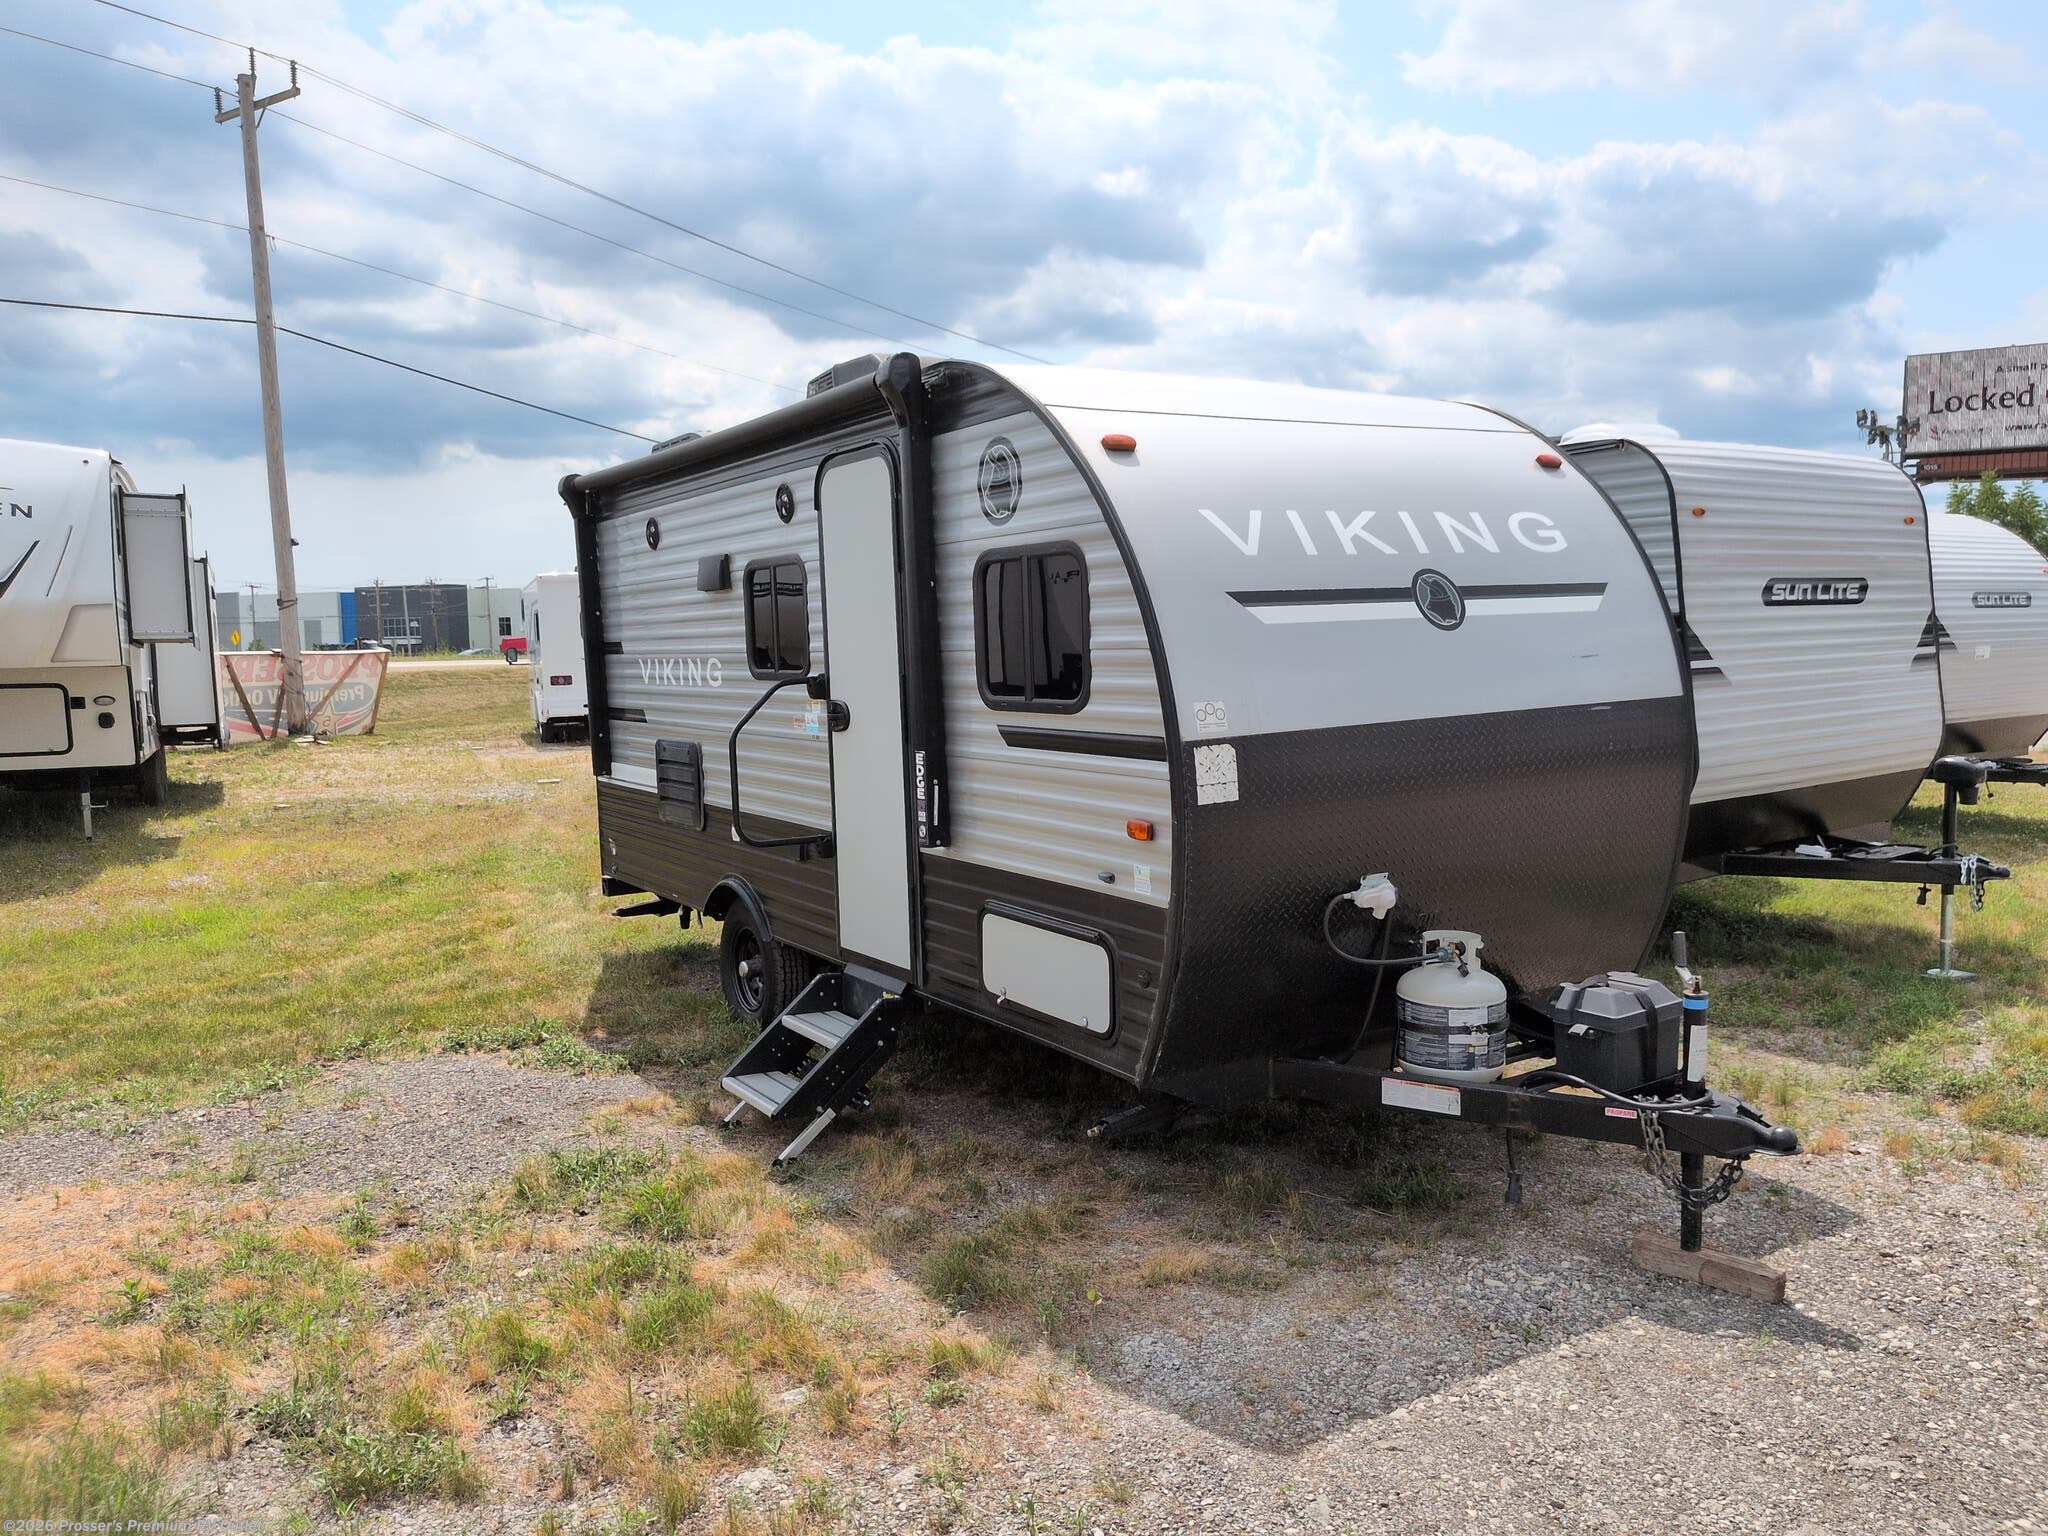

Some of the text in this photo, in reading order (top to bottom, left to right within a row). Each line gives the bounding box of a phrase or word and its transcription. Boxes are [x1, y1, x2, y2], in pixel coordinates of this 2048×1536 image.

[1928, 382, 2035, 414] Locked
[0, 502, 33, 519] N
[1197, 509, 1568, 556] VIKING
[638, 657, 723, 687] VIKING
[915, 752, 926, 800] EDGE
[1606, 1107, 1636, 1118] PROPANE
